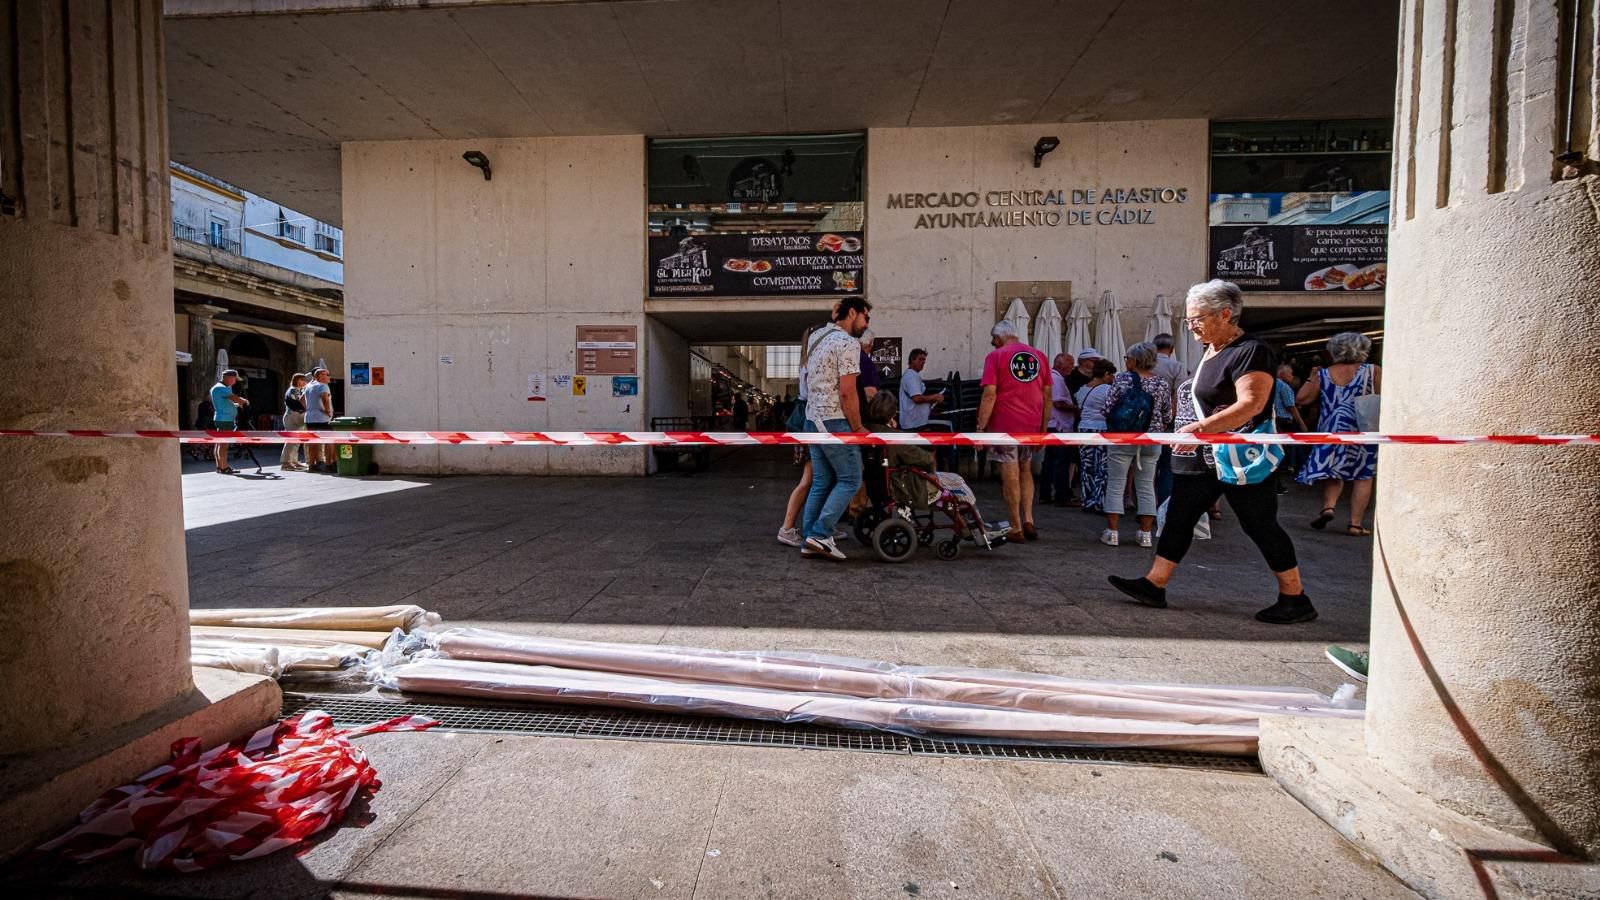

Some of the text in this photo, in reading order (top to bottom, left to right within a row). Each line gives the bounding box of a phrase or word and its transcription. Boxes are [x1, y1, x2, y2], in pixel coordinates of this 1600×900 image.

[887, 187, 1188, 209] MERCADO CENTRAL DE ABASTOS
[914, 205, 1155, 229] AYUNTAMIENTO DE CÁDIZ
[1304, 227, 1314, 236] Te
[1316, 228, 1369, 238] preparamos
[751, 236, 811, 246] DESAYUNOS
[1345, 235, 1383, 246] pescado
[1310, 246, 1328, 256] que
[1329, 246, 1369, 255] compres
[775, 255, 864, 266] ALMUERZOS Y CENAS
[753, 276, 822, 286] COMBINADOS
